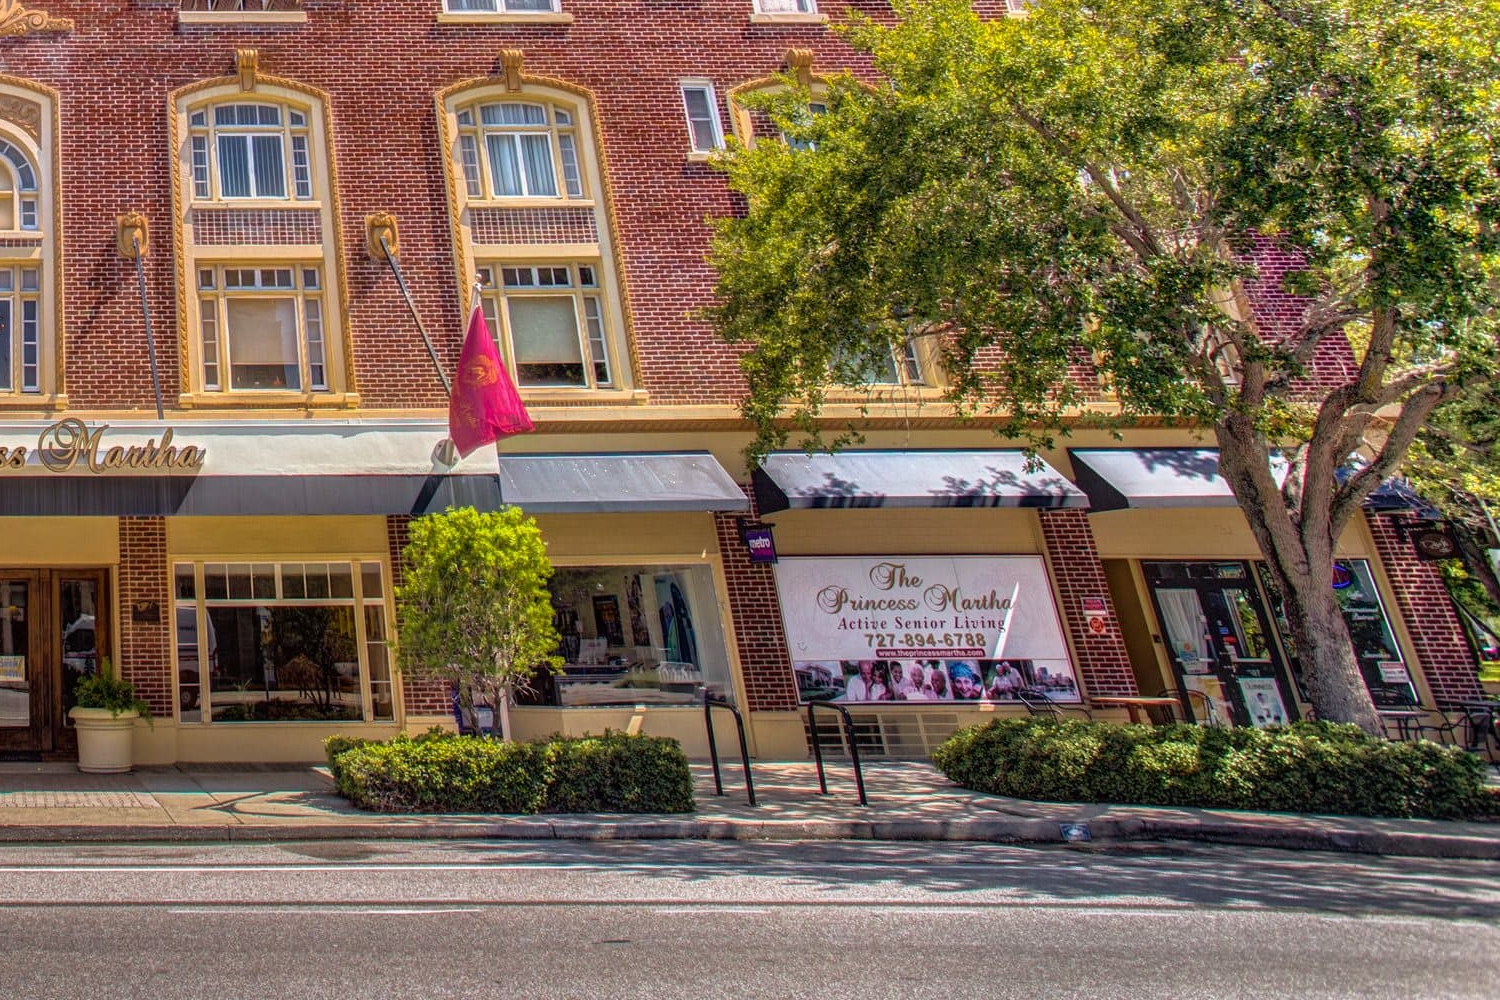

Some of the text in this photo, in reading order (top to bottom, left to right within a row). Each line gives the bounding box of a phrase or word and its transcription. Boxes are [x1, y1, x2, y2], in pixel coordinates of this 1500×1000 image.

[38, 417, 206, 474] Martha
[749, 536, 770, 548] metro
[869, 562, 923, 590] The
[817, 584, 1014, 614] Princess Martha
[837, 616, 1005, 632] Active Senior Living
[865, 633, 986, 647] 727-894-6788
